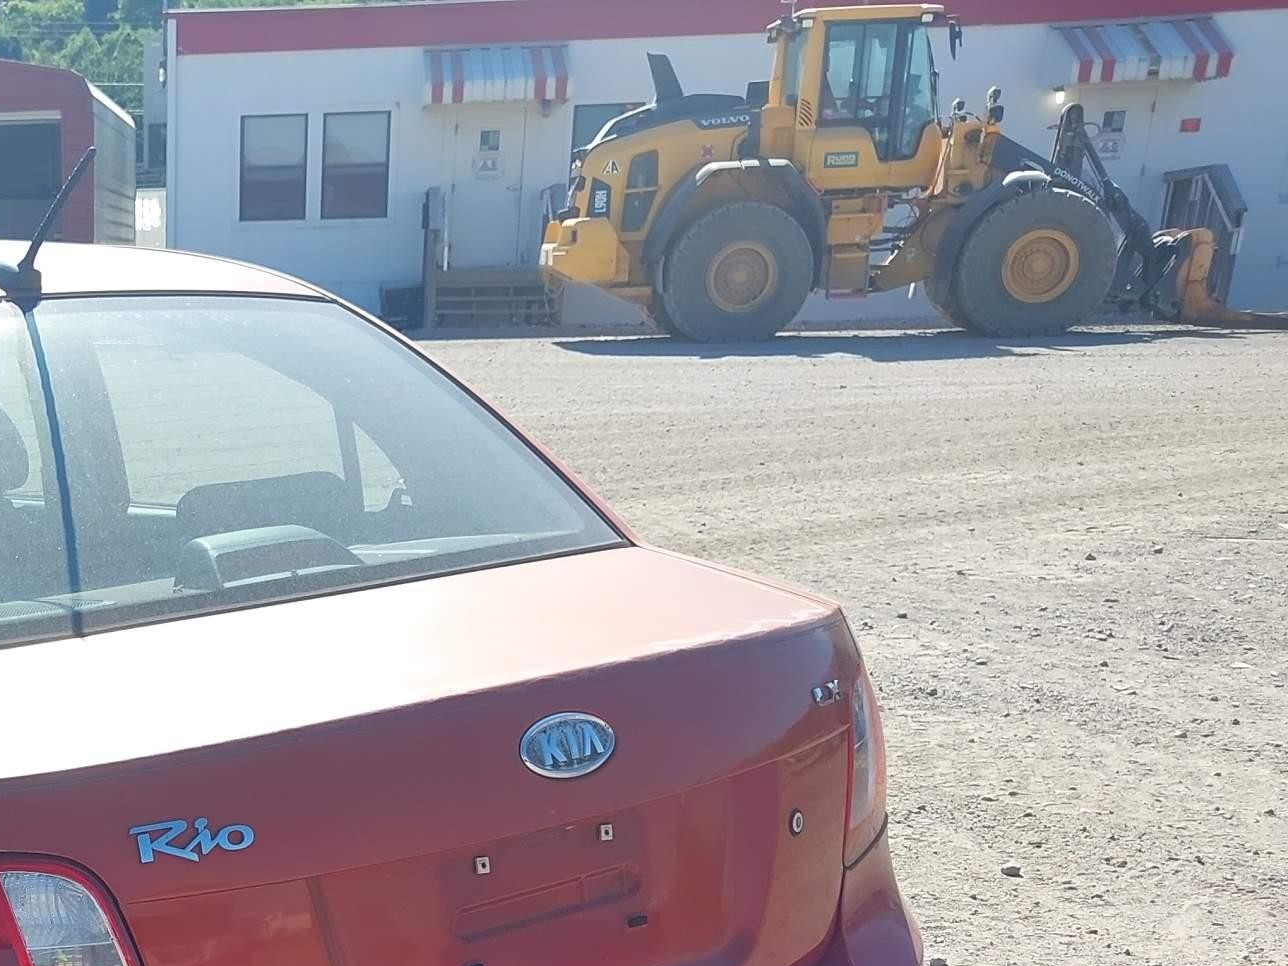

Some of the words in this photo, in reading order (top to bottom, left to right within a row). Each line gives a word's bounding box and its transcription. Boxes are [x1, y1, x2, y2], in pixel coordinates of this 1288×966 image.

[700, 114, 750, 126] VOLVO
[594, 190, 607, 213] L90H
[534, 719, 607, 768] KIA
[129, 817, 255, 863] Rio
